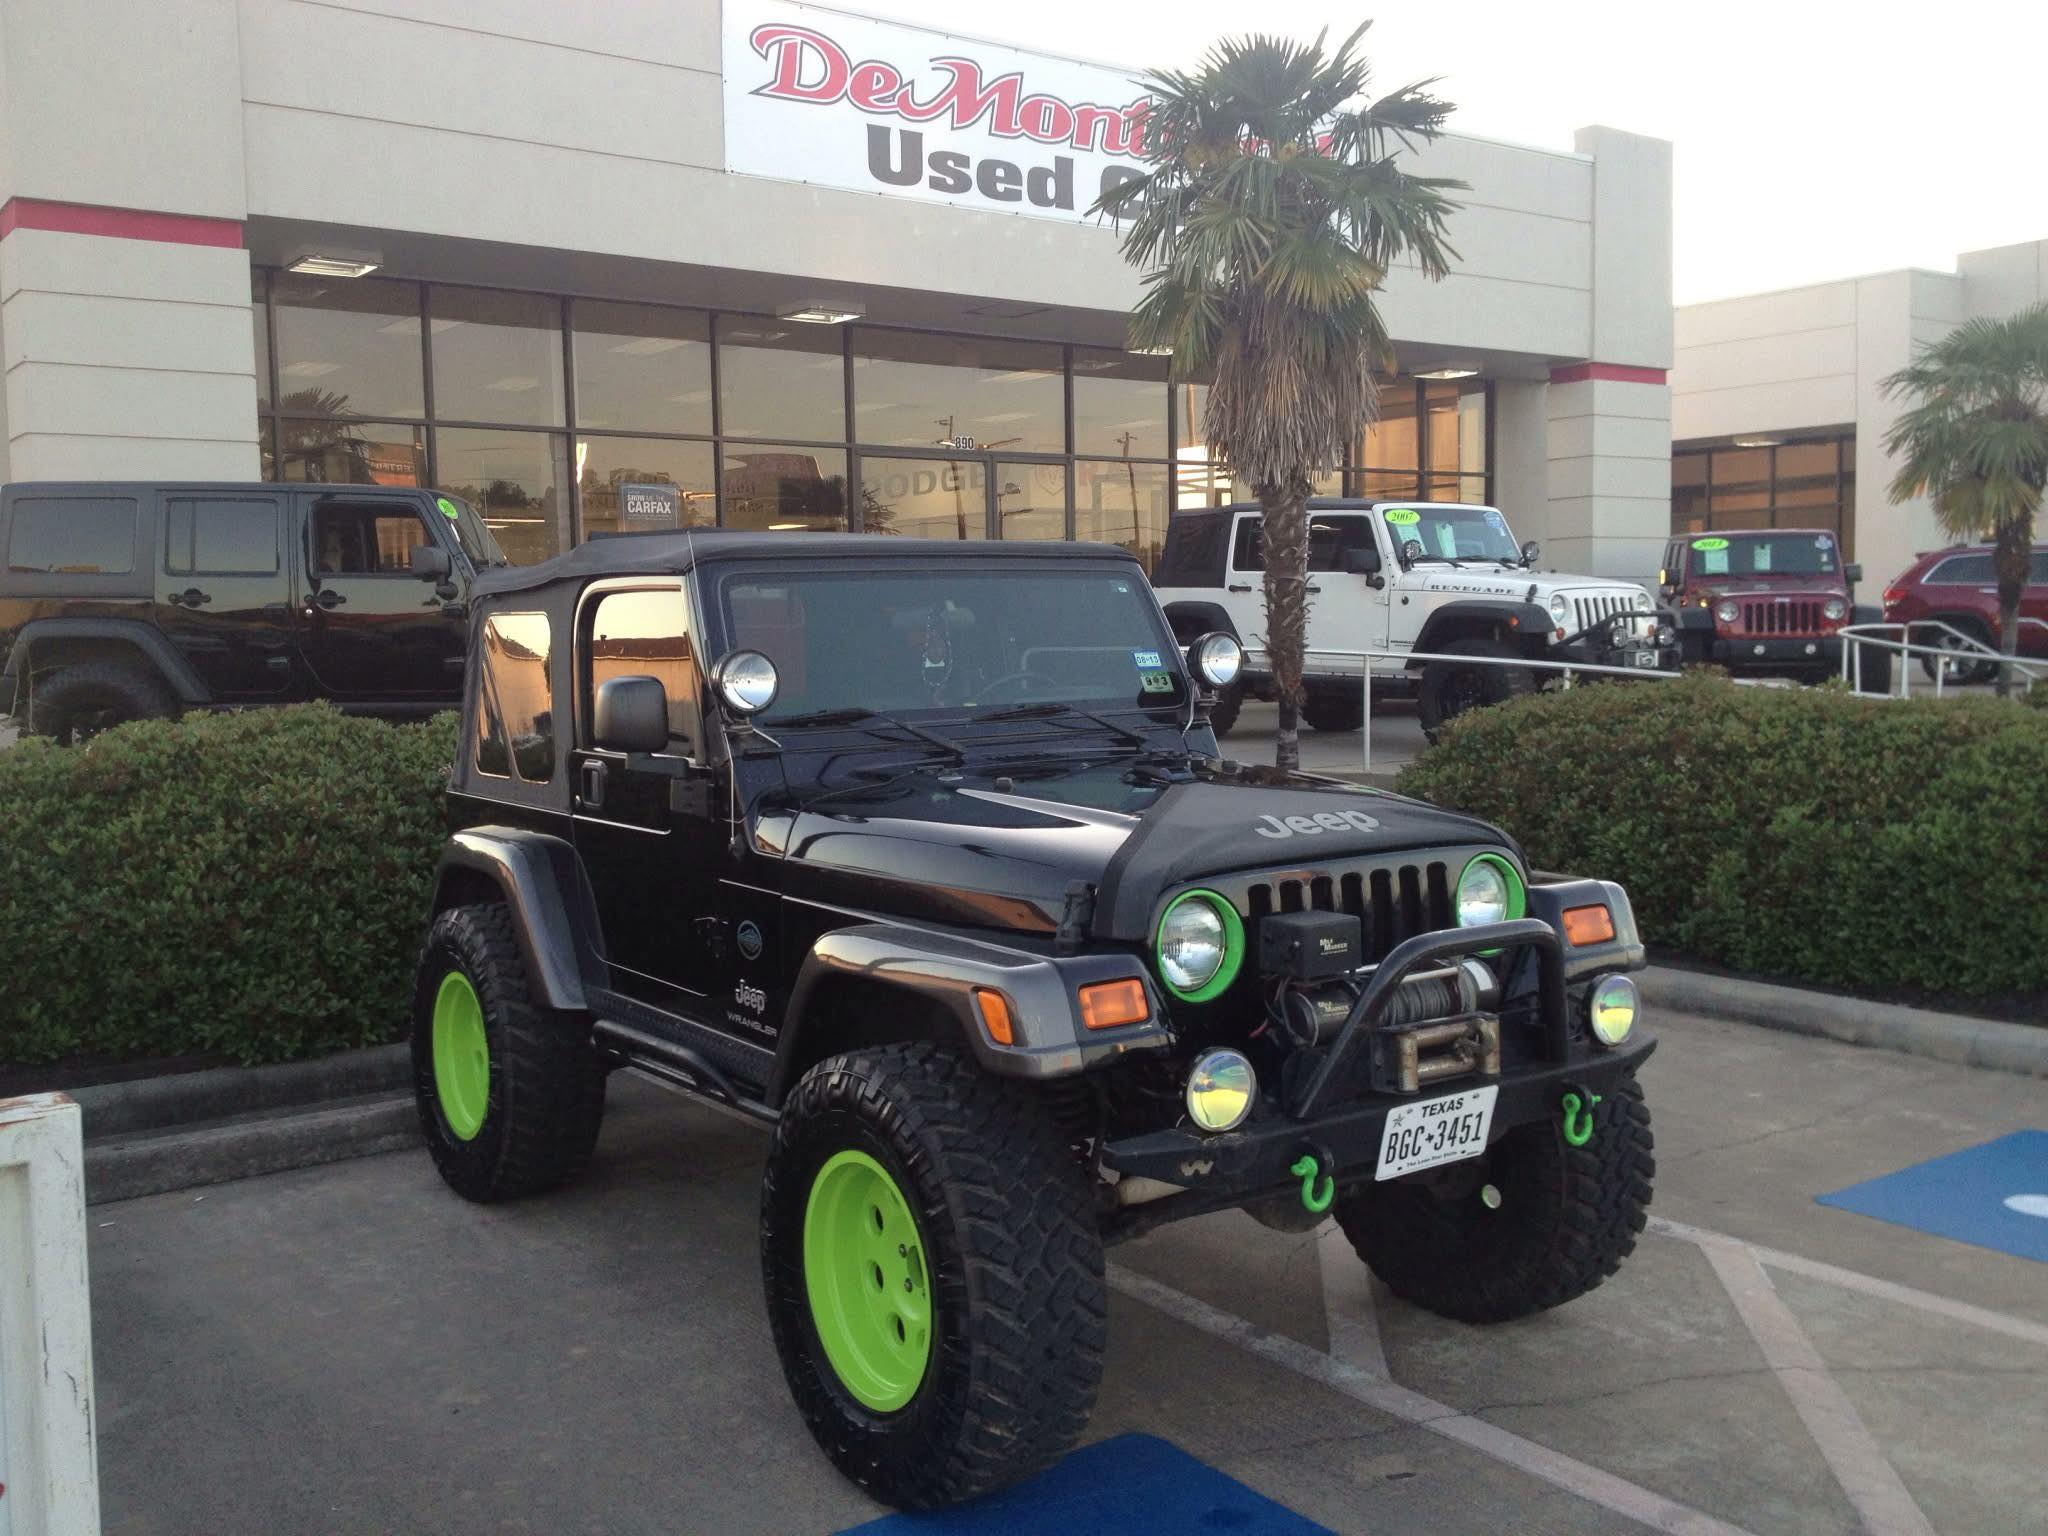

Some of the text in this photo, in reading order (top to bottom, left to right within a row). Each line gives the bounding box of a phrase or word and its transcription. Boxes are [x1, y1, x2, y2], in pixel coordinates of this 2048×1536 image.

[749, 22, 1340, 172] DeMont
[866, 123, 1075, 211] Used
[955, 436, 974, 450] 890
[866, 463, 985, 498] ODGE
[627, 501, 672, 514] CARFAX
[1391, 512, 1414, 521] 2007
[1430, 584, 1515, 595] RENEGADE
[1254, 810, 1380, 839] Jeep
[735, 979, 766, 1014] Jeep
[727, 1011, 777, 1036] WRANGLER
[1422, 1097, 1464, 1118] TEXAS
[1385, 1111, 1483, 1164] BGC 3451
